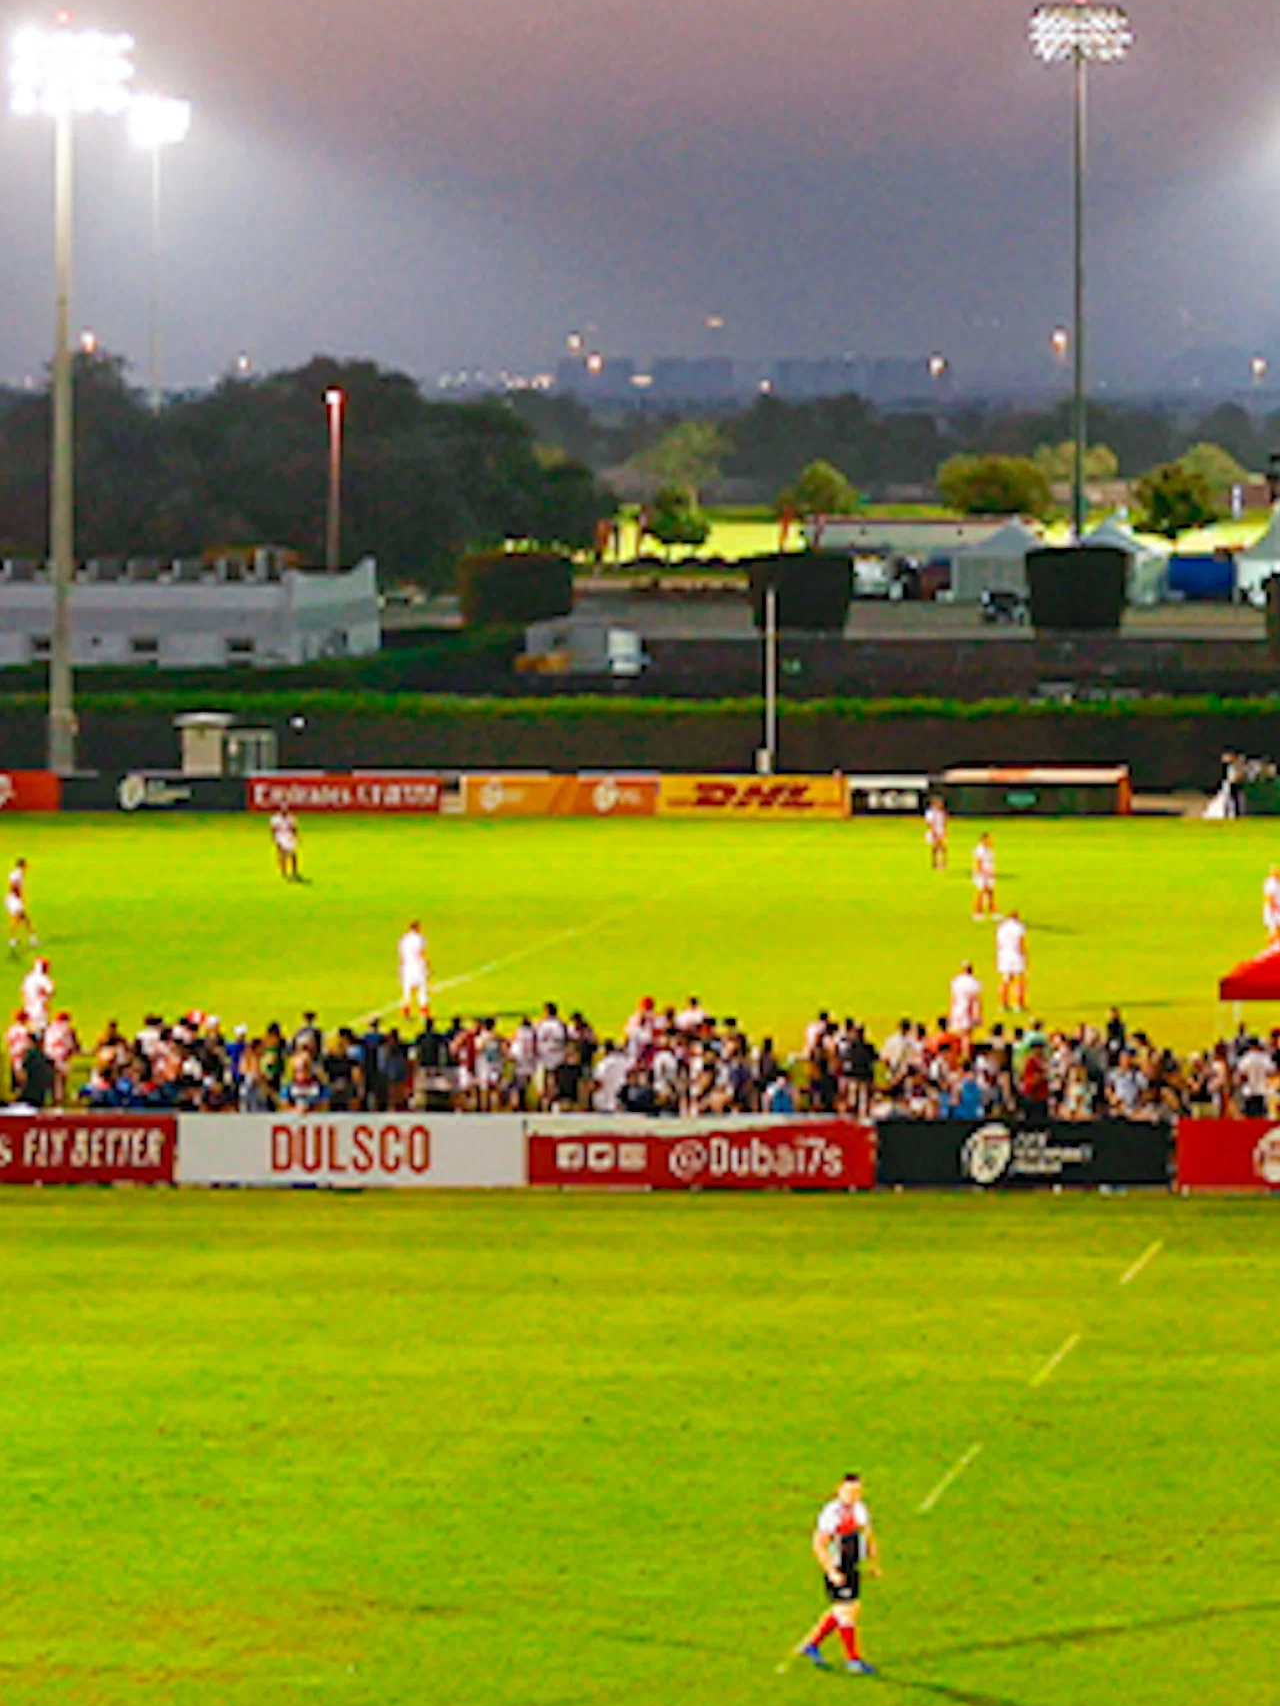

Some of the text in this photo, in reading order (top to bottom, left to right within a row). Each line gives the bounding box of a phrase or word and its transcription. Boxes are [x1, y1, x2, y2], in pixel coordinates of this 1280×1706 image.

[70, 1127, 166, 1167] BETTER
[272, 1124, 430, 1174] DULSCO
[668, 1135, 843, 1182] @Dubai7s
